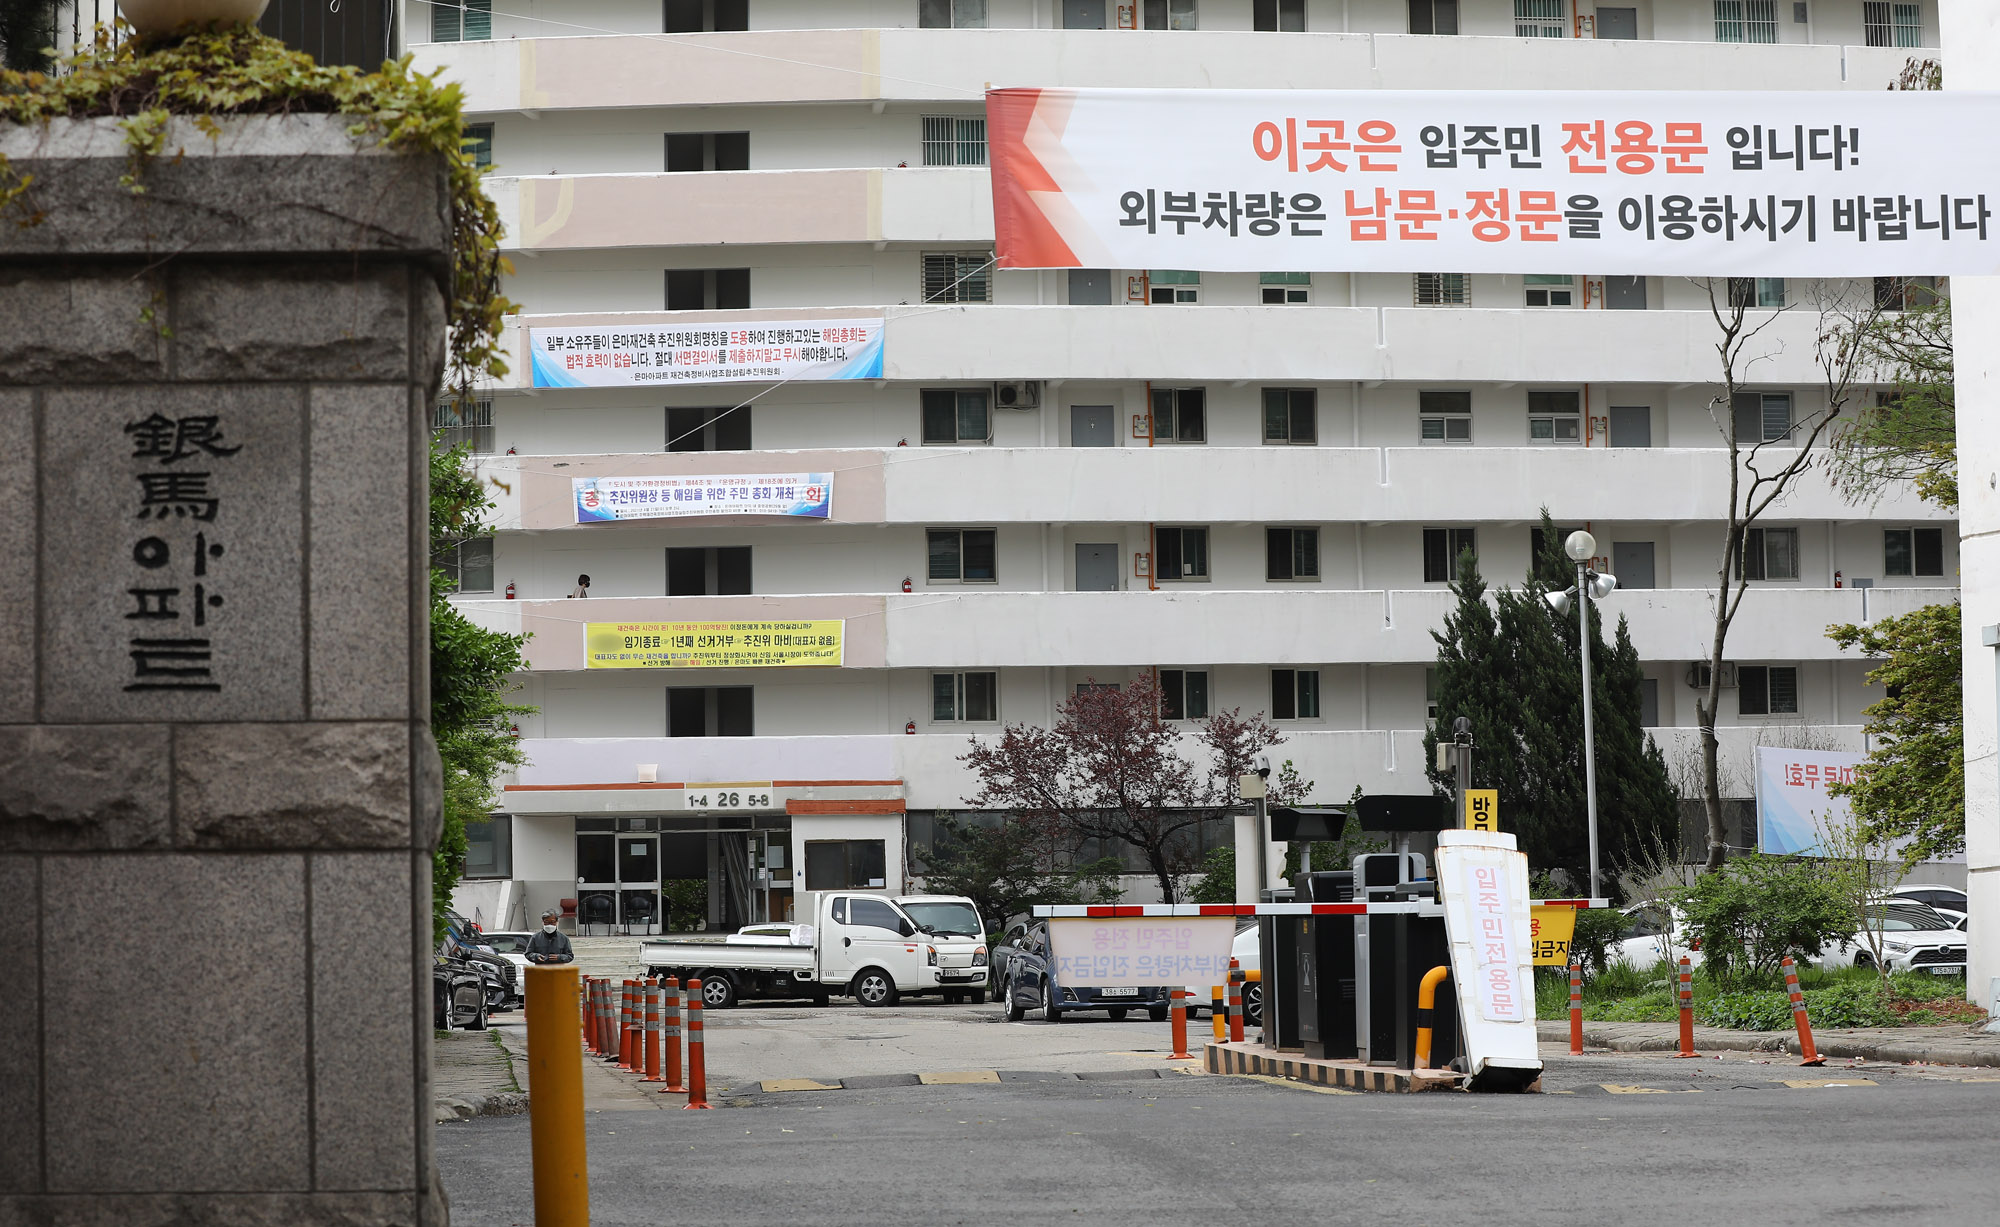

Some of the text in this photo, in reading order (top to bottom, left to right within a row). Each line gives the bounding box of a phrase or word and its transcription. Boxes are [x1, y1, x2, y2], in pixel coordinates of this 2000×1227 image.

[1252, 118, 1859, 175] 이곳은 입주민 전용문 입니다!
[1119, 188, 1327, 237] 외부차량은
[1618, 194, 1816, 242] 이용하시기
[1832, 194, 1992, 242] 바랍니다
[546, 327, 867, 351] 일부 소유주들이 은마재건축 추진위원회명칭을 도용하여 진행하고있는 해임총회는
[566, 346, 848, 369] 법적 효력이 없습니다. 절대 서면결의서를 제출하지말고 무시해야합니다.
[634, 372, 669, 381] 은마아파트
[585, 490, 599, 507] 총
[609, 486, 794, 505] 추진위원장 등 해임을 위한 주민 총회 개최
[806, 486, 821, 503] 회
[624, 635, 661, 649] 임기종료
[670, 635, 694, 648] 1년째
[697, 634, 734, 648] 선거거부
[743, 634, 771, 647] 추진위
[688, 792, 769, 807] 1-4 26 5-8
